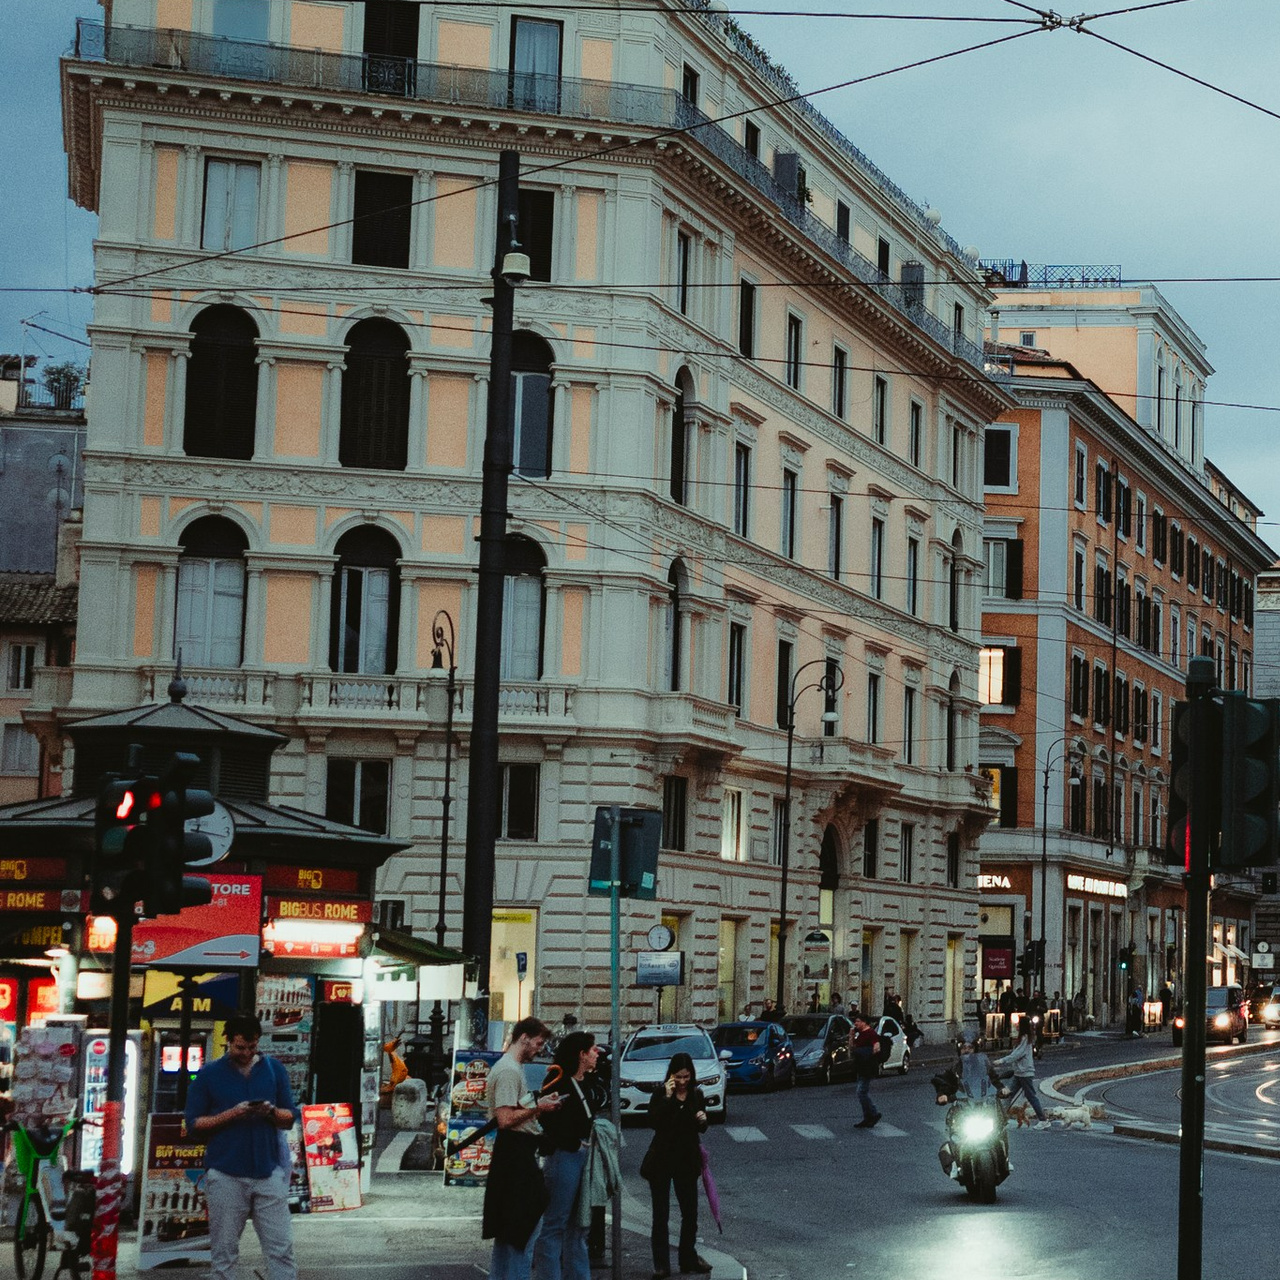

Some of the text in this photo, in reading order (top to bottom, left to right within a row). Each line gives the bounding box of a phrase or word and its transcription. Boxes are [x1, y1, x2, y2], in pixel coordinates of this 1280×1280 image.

[978, 875, 1011, 888] IENA
[212, 883, 251, 895] TORE
[7, 892, 46, 908] ROME
[324, 903, 358, 920] ROME
[170, 997, 212, 1012] AM
[155, 1149, 173, 1158] BUY
